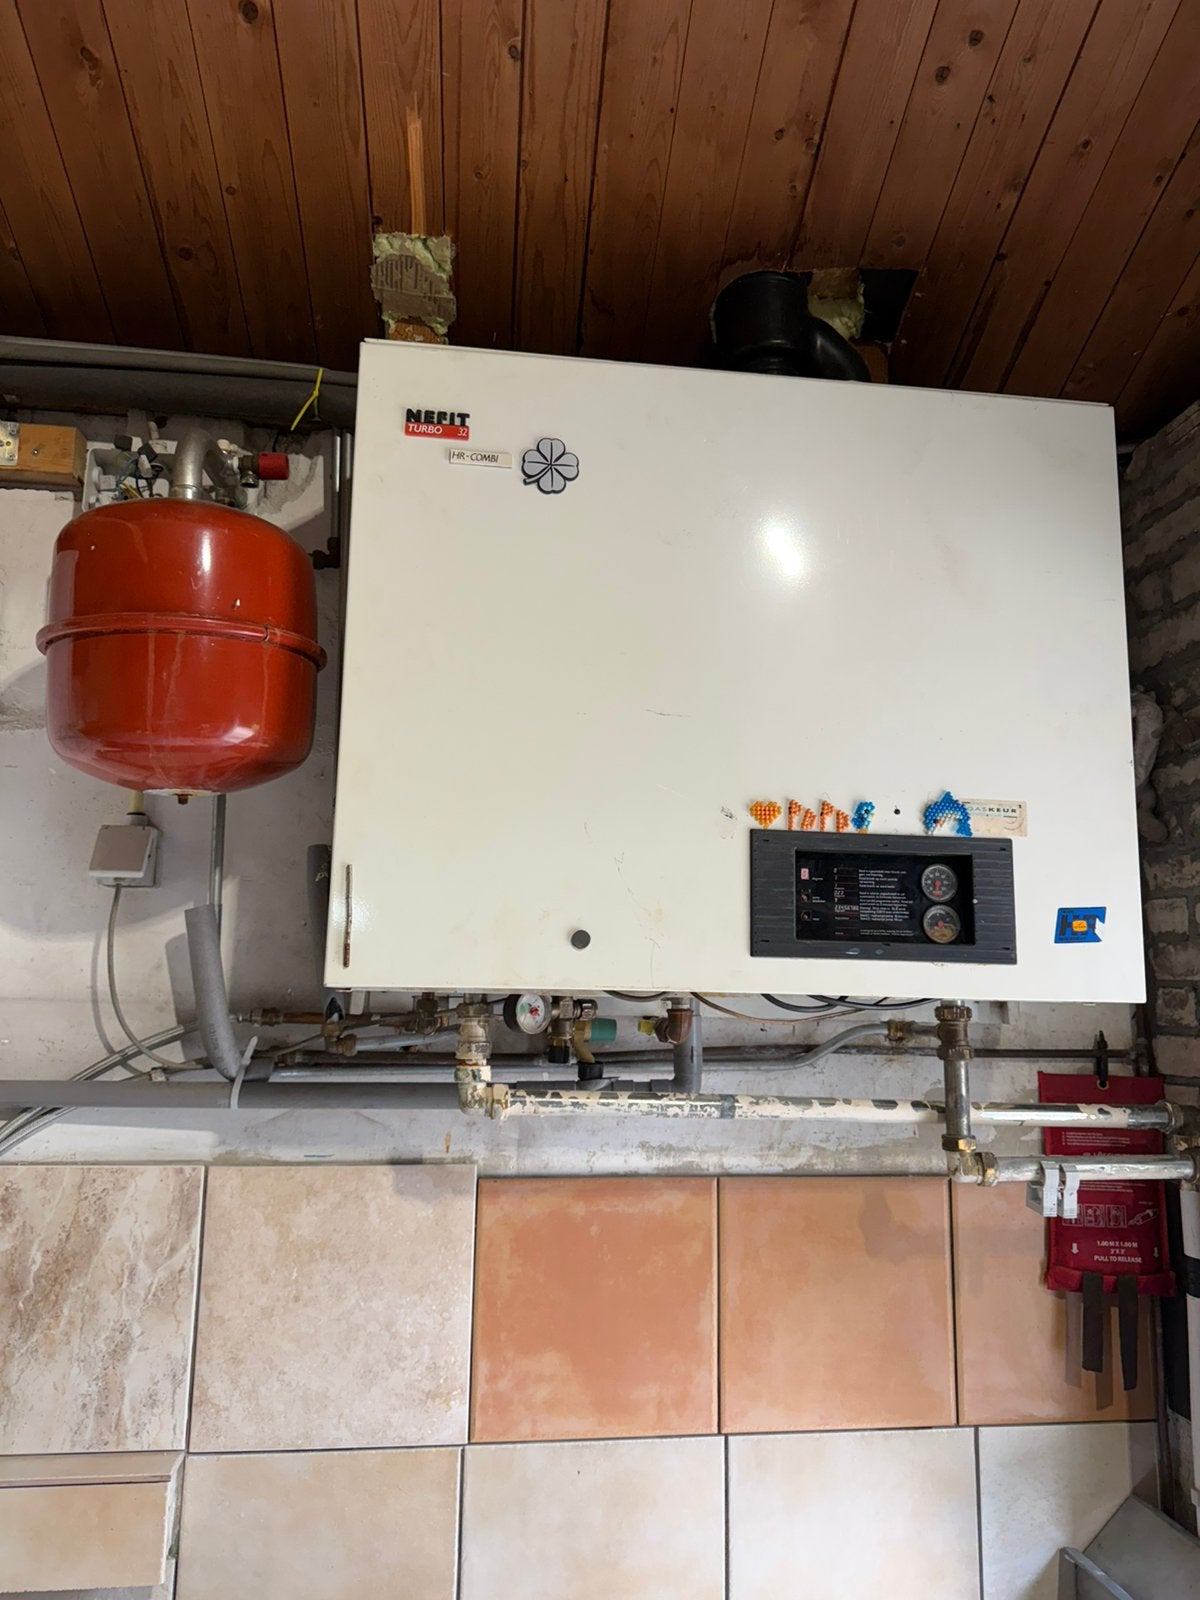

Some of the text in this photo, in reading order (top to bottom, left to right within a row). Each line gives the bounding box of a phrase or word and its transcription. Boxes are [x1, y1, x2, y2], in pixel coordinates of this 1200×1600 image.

[405, 408, 470, 426] NEFIT
[408, 424, 468, 437] TURBO 32
[1117, 1256, 1142, 1264] RELEASE
